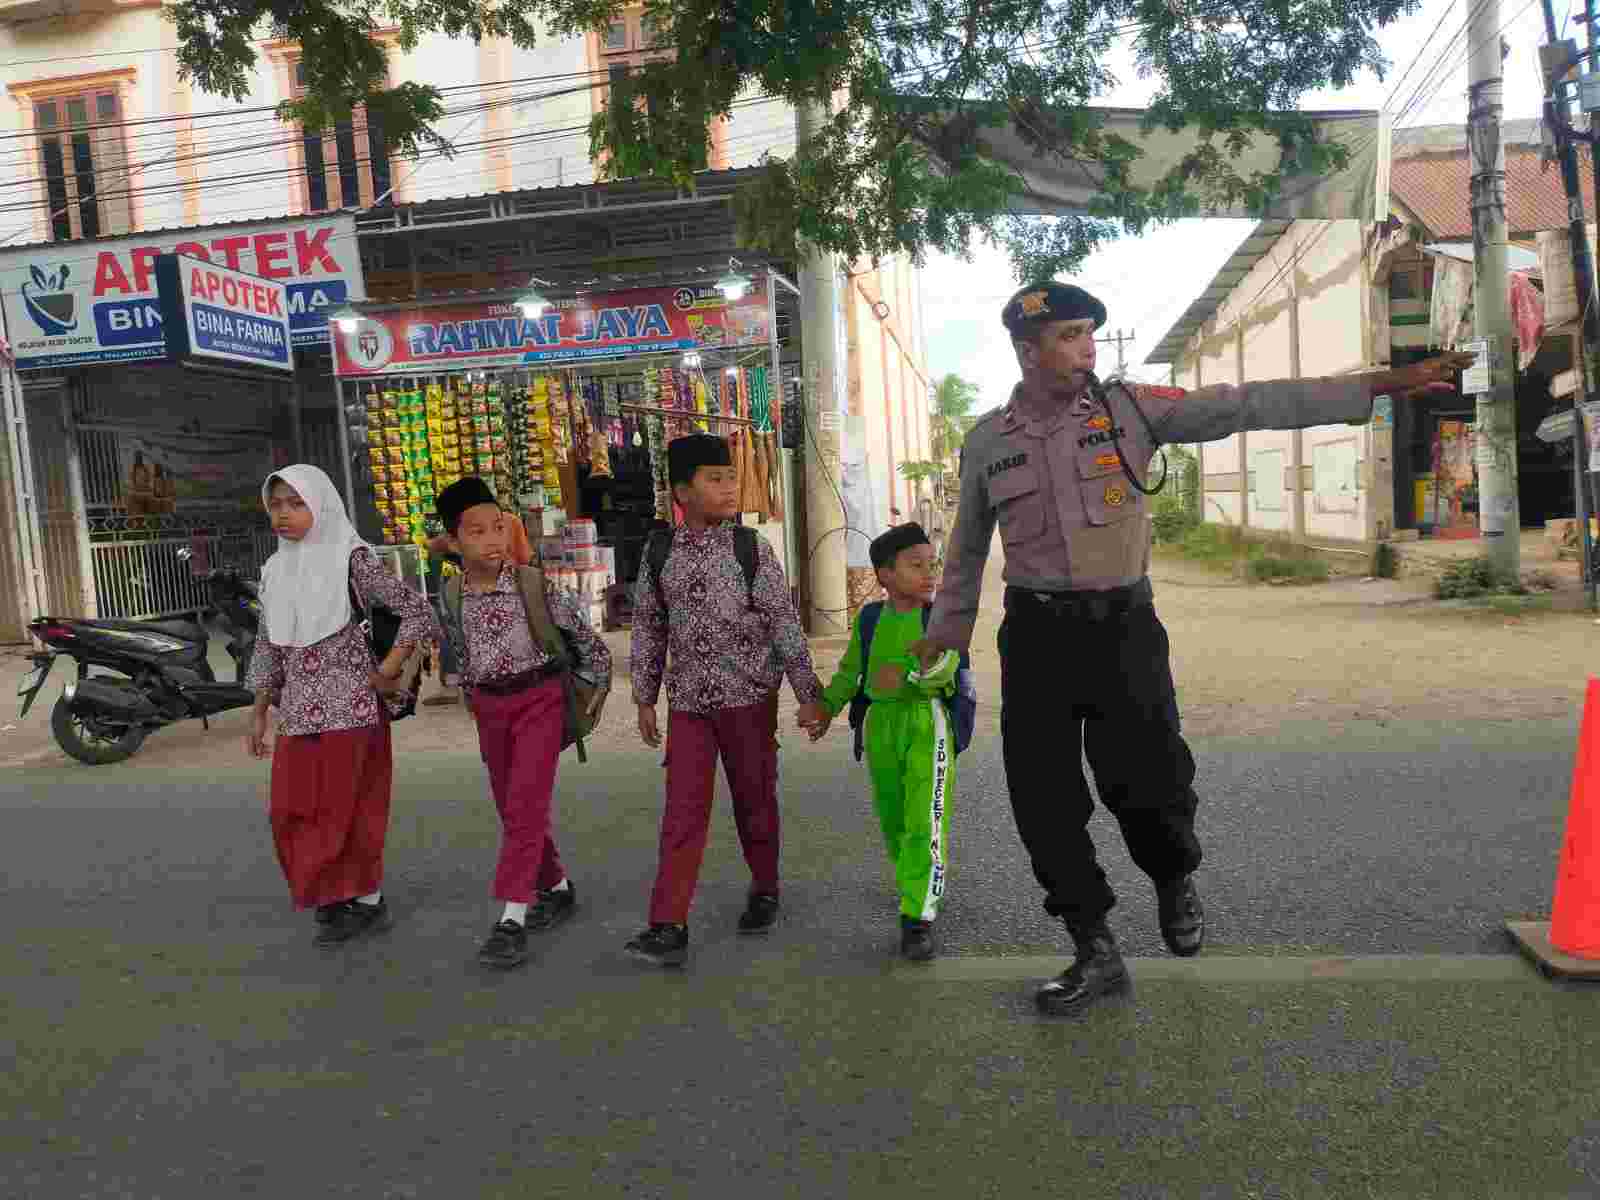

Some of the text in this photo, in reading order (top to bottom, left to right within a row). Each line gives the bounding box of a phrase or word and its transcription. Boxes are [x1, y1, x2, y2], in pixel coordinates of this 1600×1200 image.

[191, 267, 283, 318] APOTEK
[196, 310, 284, 346] BINA FARMA
[409, 314, 565, 355] RAHMAT
[578, 304, 674, 340] JAYA
